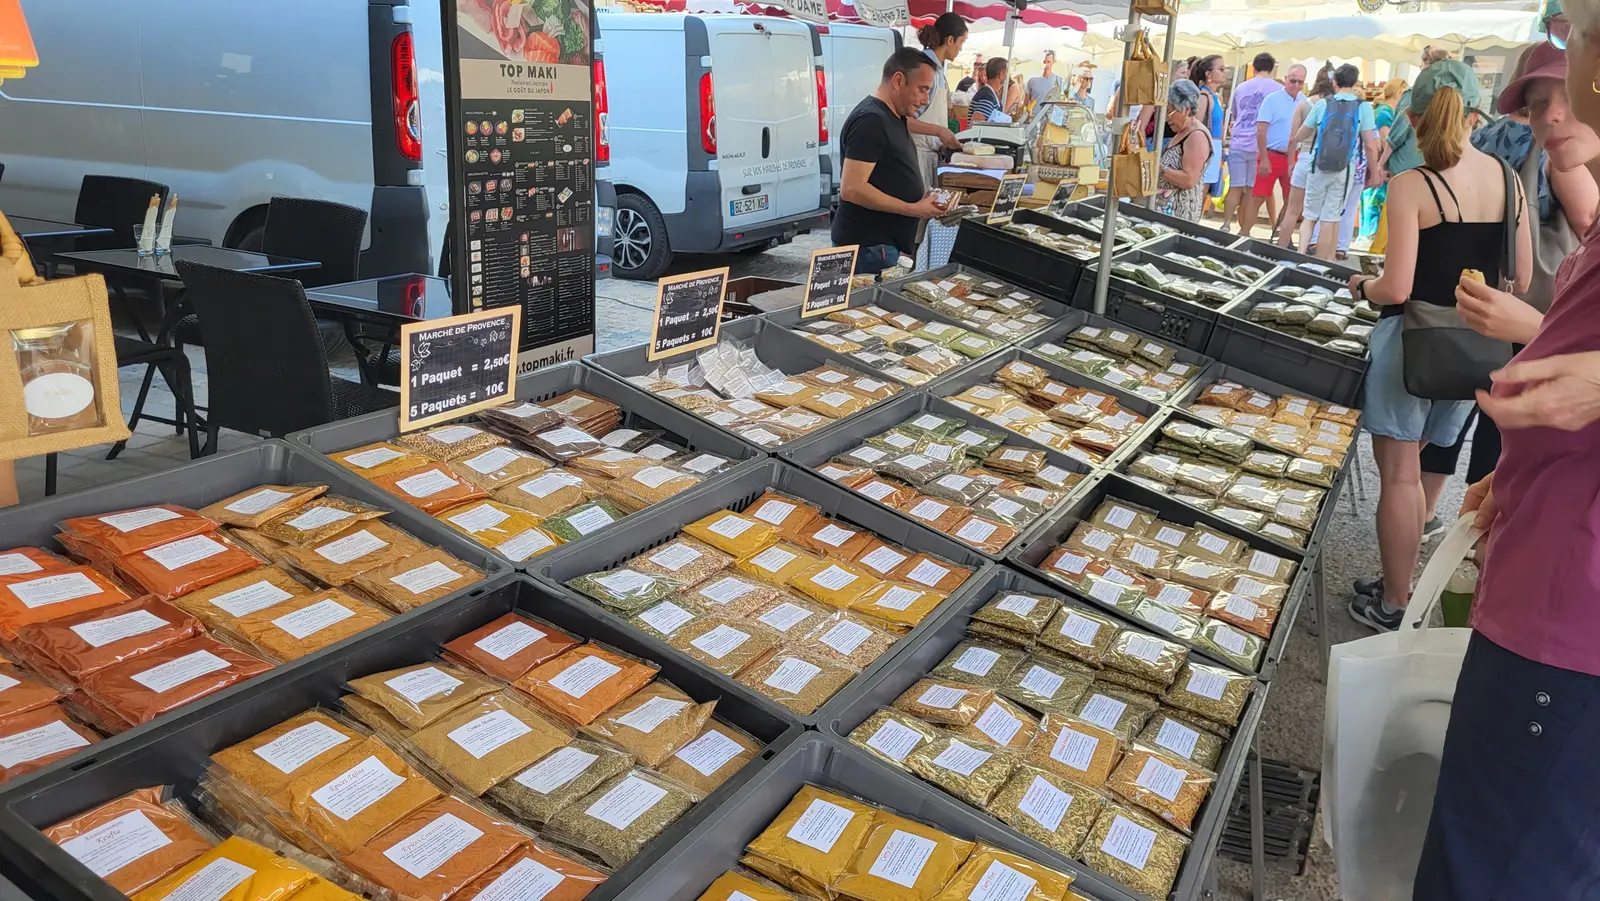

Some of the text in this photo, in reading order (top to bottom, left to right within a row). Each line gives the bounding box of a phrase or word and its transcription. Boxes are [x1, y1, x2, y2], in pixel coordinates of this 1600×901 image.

[500, 64, 556, 80] TOP MAKI
[696, 277, 720, 286] PROVENCE
[814, 280, 830, 290] Paquet
[811, 299, 829, 308] Paquets
[837, 294, 845, 302] 10€
[660, 318, 663, 326] 1
[665, 312, 690, 326] Paquet
[702, 305, 719, 317] 2,50€
[419, 318, 506, 341] MARCHÉ DE PROVENCE
[656, 341, 661, 350] 5
[662, 334, 690, 348] Paquets
[701, 327, 713, 337] 10€
[411, 354, 510, 388] 1 Paquet = 2,50€
[410, 405, 417, 417] 5
[422, 394, 467, 414] Paquets
[485, 382, 504, 396] 10€
[347, 768, 364, 782] Tajine
[400, 839, 421, 852] Epices
[170, 874, 200, 898] Curcuma
